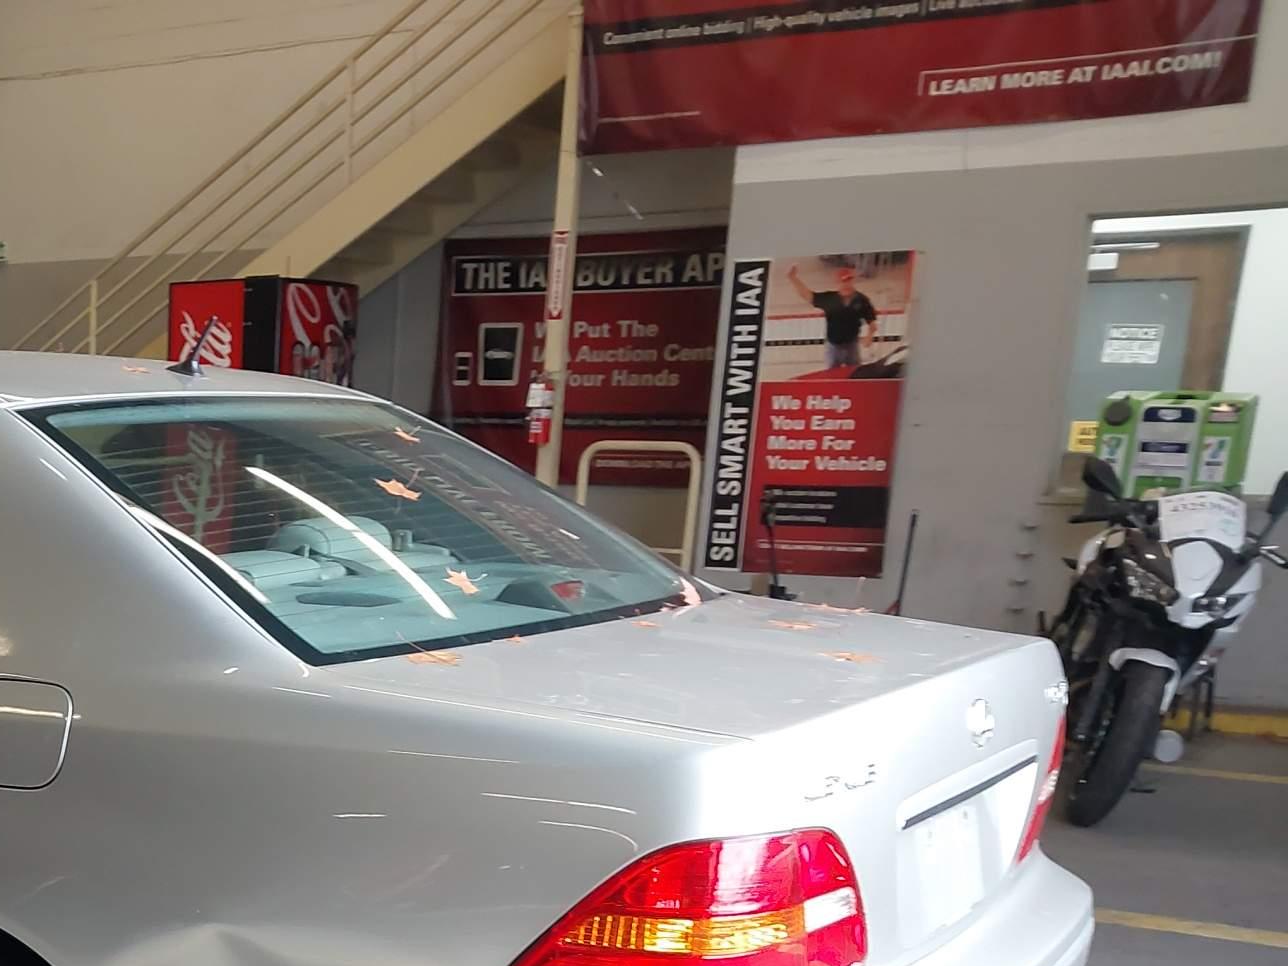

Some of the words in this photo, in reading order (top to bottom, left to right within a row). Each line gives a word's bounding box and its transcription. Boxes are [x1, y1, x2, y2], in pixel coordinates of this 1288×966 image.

[603, 29, 664, 45] Convenient
[665, 25, 701, 39] online
[703, 20, 745, 35] bidding
[754, 11, 826, 31] High-quality
[828, 8, 872, 22] vehicle
[875, 3, 918, 19] images
[928, 76, 997, 96] LEARN
[999, 70, 1065, 91] MORE
[1067, 66, 1098, 84] AT
[462, 261, 511, 289] THE
[519, 261, 546, 289] IA
[576, 258, 674, 287] BUYER
[681, 252, 725, 283] AP
[734, 267, 765, 315] IAA
[573, 321, 612, 338] Put
[617, 320, 659, 338] The
[575, 345, 658, 362] Auction
[663, 343, 715, 362] Cent
[726, 323, 759, 396] WITH
[612, 370, 681, 387] Hands
[771, 395, 802, 410] We
[805, 395, 852, 413] Help
[769, 415, 806, 430] You
[810, 415, 856, 430] Earn
[716, 402, 749, 496] SMART
[767, 435, 817, 450] More
[821, 435, 856, 450] For
[765, 455, 810, 470] Your
[814, 455, 887, 471] Vehicle
[710, 502, 740, 562] SELL
